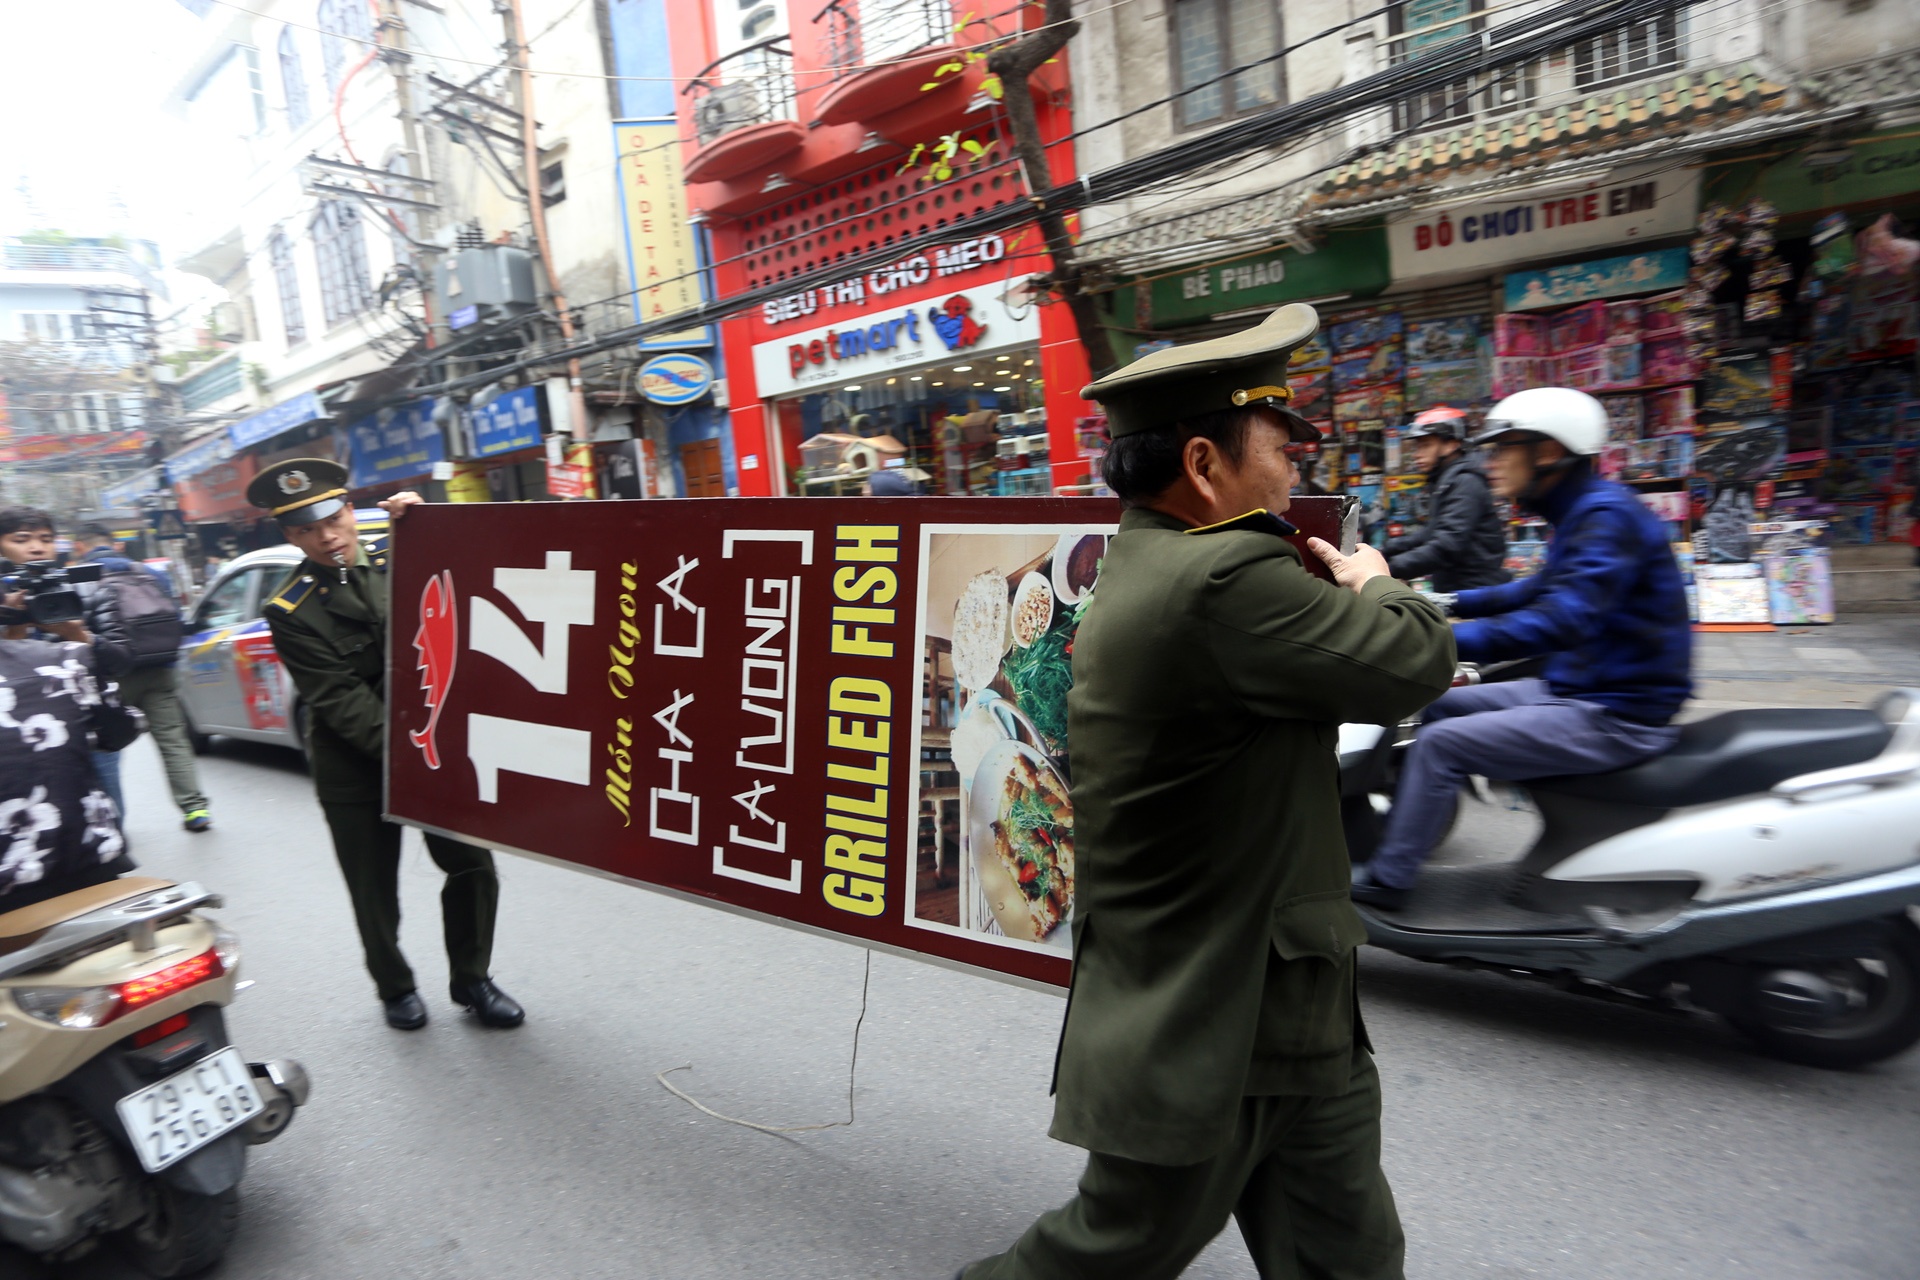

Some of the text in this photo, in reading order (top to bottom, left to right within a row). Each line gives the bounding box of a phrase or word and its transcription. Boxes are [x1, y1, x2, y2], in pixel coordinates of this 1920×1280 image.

[1221, 259, 1285, 292] PHAO
[1607, 181, 1656, 217] EM
[788, 309, 920, 379] petmart
[467, 550, 596, 804] 14
[605, 558, 642, 828] Món Ngon
[822, 524, 900, 917] GRILLED FISH
